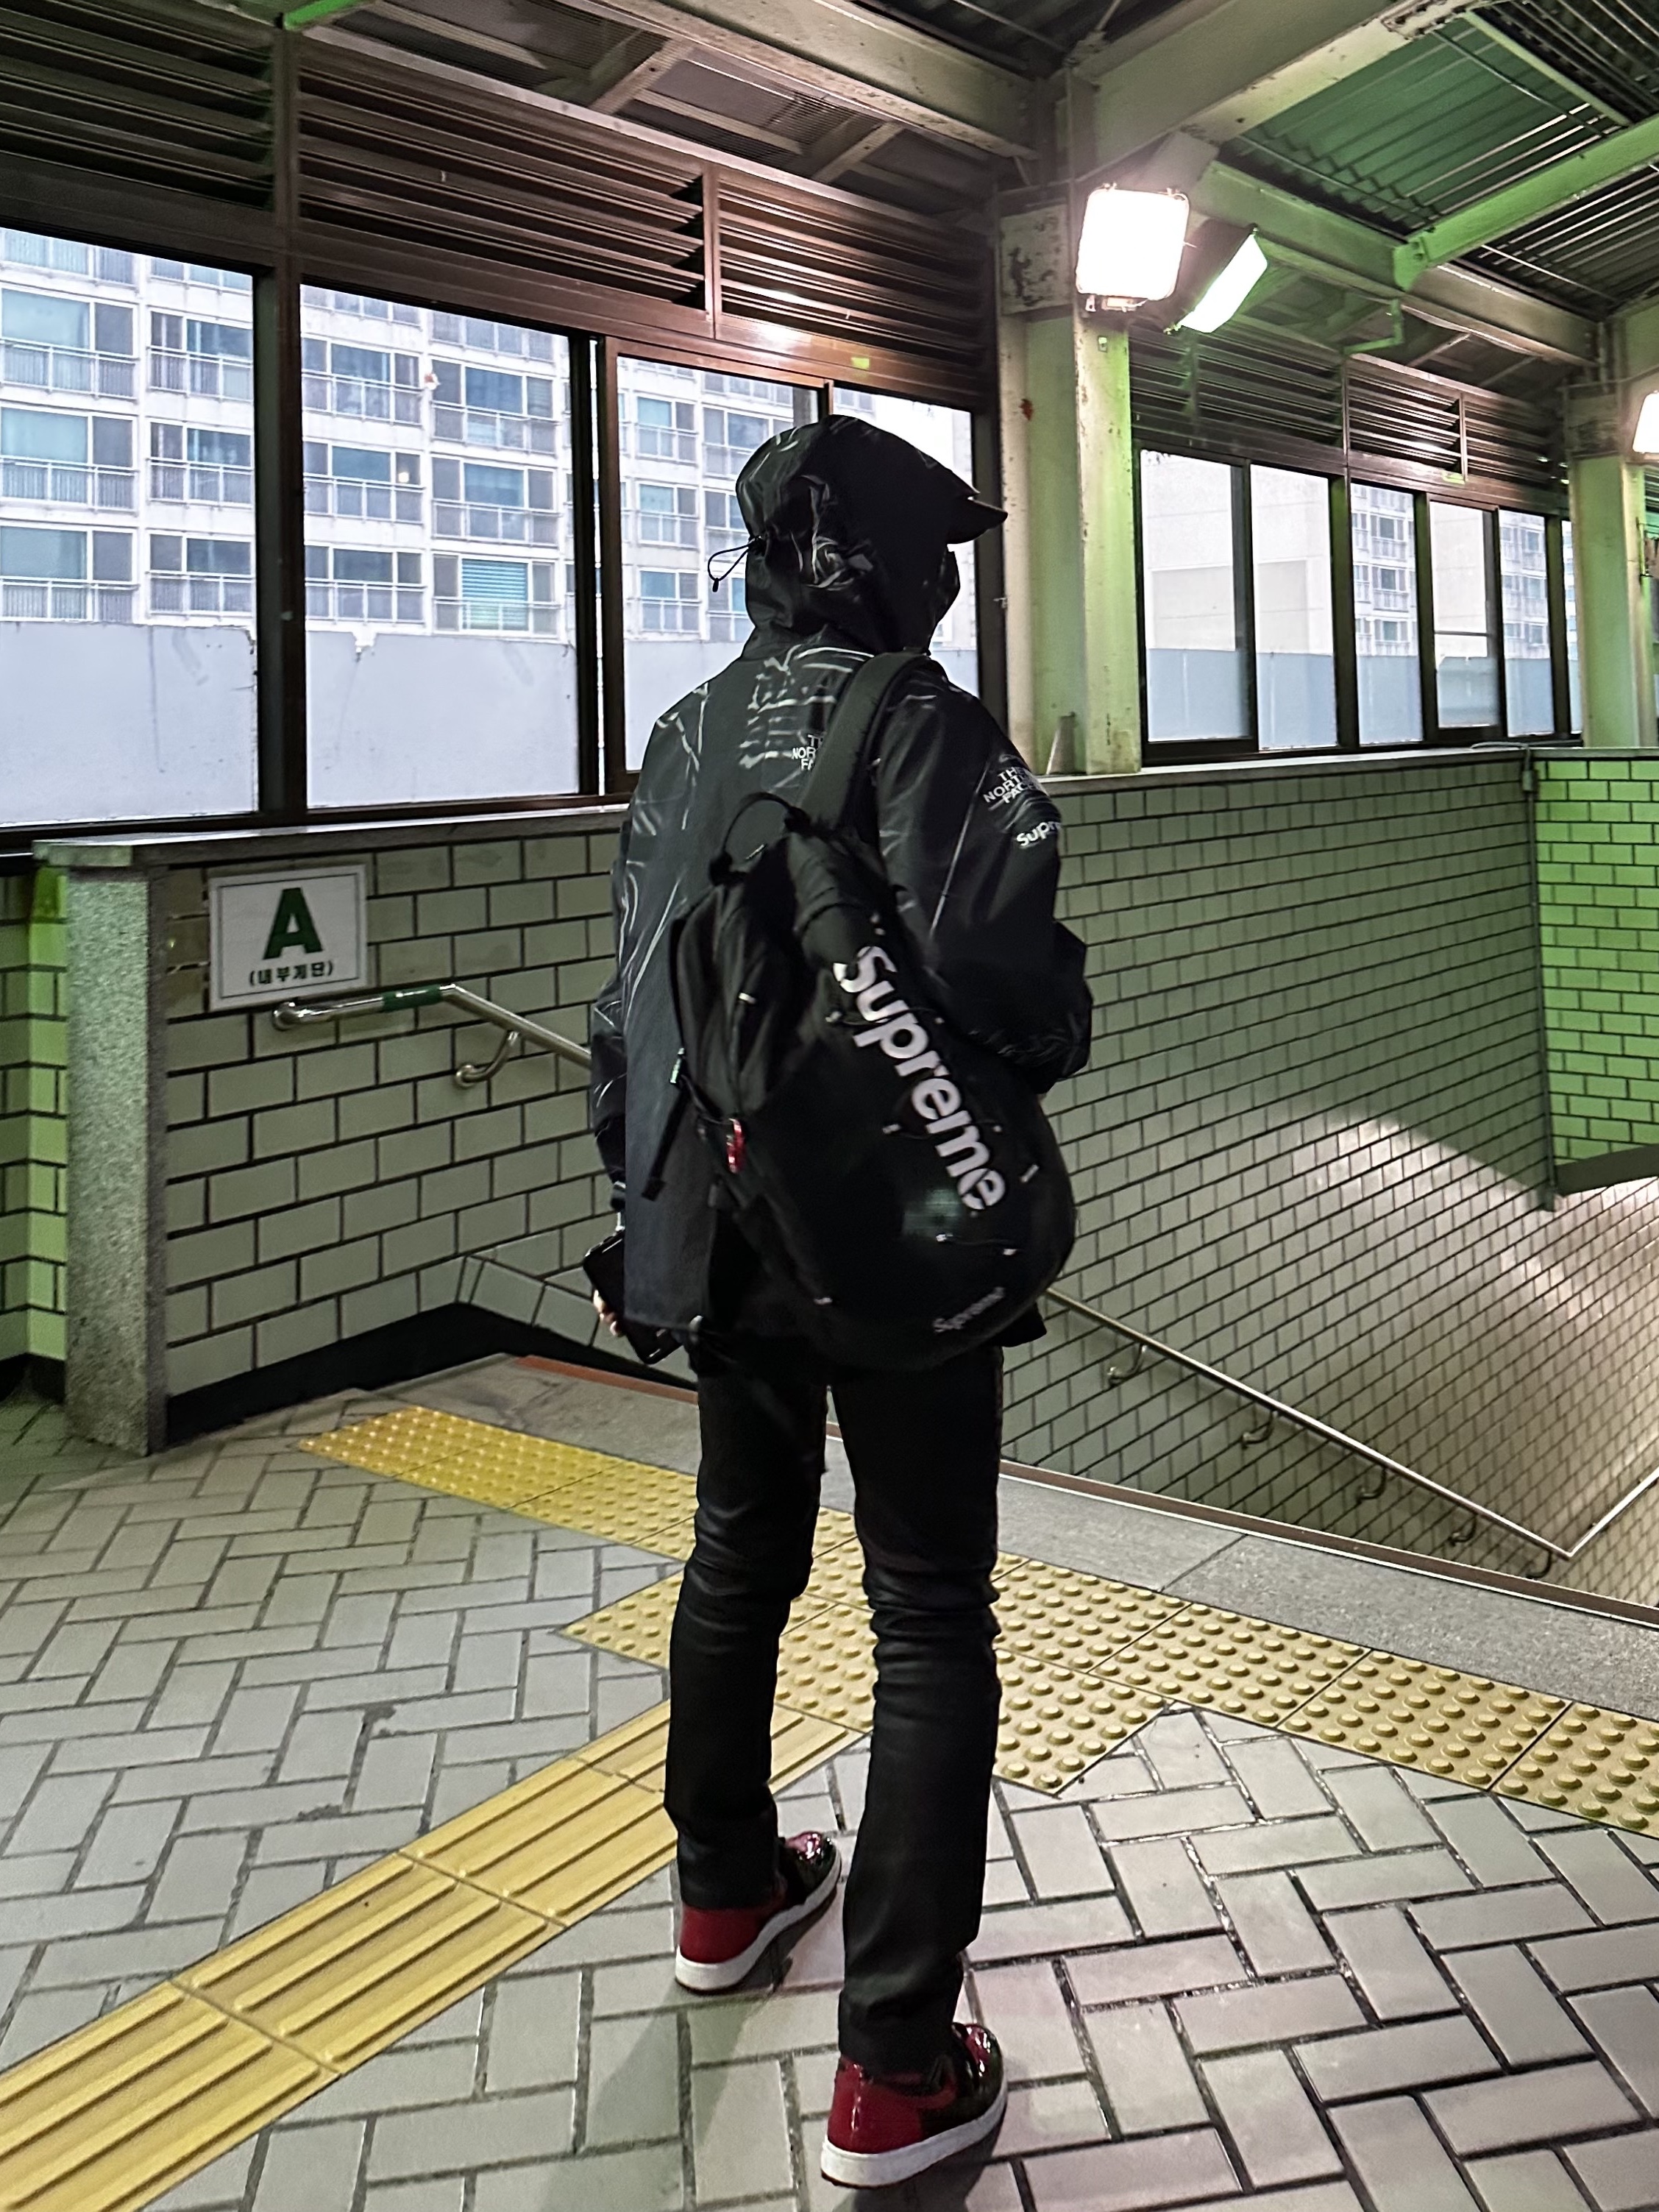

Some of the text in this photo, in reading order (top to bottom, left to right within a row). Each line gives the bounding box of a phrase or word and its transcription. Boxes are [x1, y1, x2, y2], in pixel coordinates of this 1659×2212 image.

[792, 746, 816, 759] NOR
[263, 887, 323, 960] A
[833, 946, 1006, 1210] Supreme
